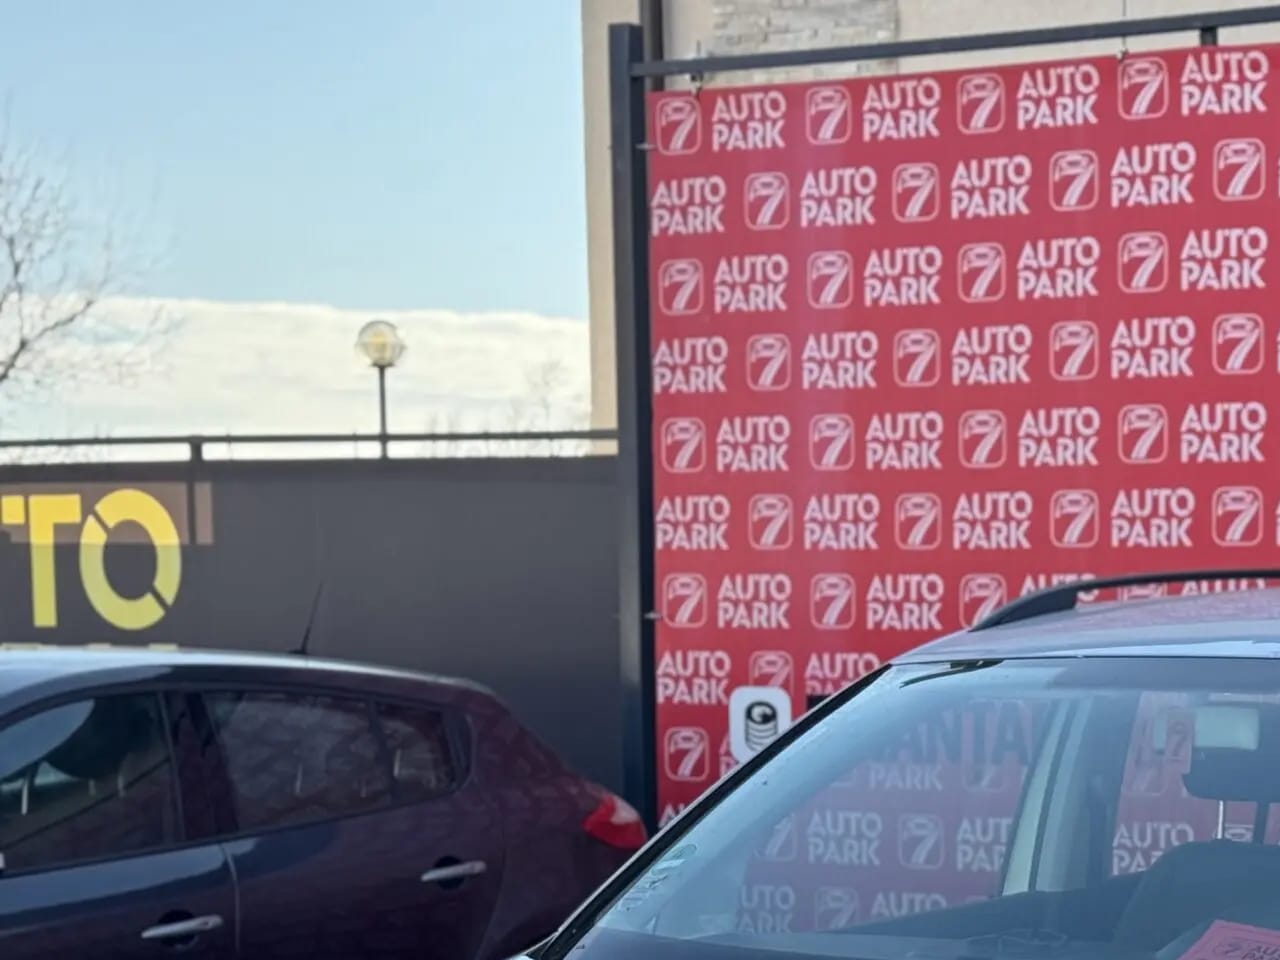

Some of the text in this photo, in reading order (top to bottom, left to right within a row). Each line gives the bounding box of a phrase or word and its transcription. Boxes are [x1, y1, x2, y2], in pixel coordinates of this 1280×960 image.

[1017, 64, 1099, 98] AUTO
[1180, 51, 1269, 86] AUTO
[711, 92, 786, 123] AUTO
[862, 78, 940, 111] AUTO
[1180, 82, 1268, 116] PARK
[862, 109, 940, 141] PARK
[1017, 95, 1098, 130] PARK
[712, 120, 786, 151] PARK
[950, 155, 1031, 189] AUTO
[1111, 142, 1195, 176] AUTO
[652, 177, 726, 207] AUTO
[800, 167, 876, 198] AUTO
[1111, 173, 1193, 207] PARK
[800, 195, 875, 227] PARK
[950, 185, 1030, 219] PARK
[652, 205, 725, 236] PARK
[1017, 236, 1099, 269] AUTO
[1180, 227, 1268, 260] AUTO
[714, 255, 788, 286] AUTO
[864, 246, 942, 278] AUTO
[1180, 257, 1266, 290] PARK
[714, 283, 787, 313] PARK
[864, 275, 941, 306] PARK
[1017, 267, 1098, 300] PARK
[802, 331, 878, 361] AUTO
[952, 324, 1032, 356] AUTO
[1111, 316, 1195, 349] AUTO
[654, 337, 728, 366] AUTO
[1111, 346, 1193, 379] PARK
[654, 364, 726, 393] PARK
[802, 359, 876, 390] PARK
[952, 353, 1031, 385] PARK
[716, 415, 790, 445] AUTO
[866, 412, 943, 442] AUTO
[1018, 407, 1100, 438] AUTO
[1180, 402, 1267, 433] AUTO
[716, 443, 788, 473] PARK
[866, 440, 942, 470] PARK
[1018, 435, 1099, 468] PARK
[1180, 431, 1265, 463] PARK
[657, 495, 730, 524] AUTO
[804, 494, 879, 522] AUTO
[953, 492, 1032, 521] AUTO
[1112, 488, 1195, 519] AUTO
[657, 522, 729, 551] PARK
[804, 520, 878, 551] PARK
[953, 520, 1031, 550] PARK
[1112, 517, 1193, 549] PARK
[1, 488, 181, 631] TO
[717, 575, 791, 602] AUTO
[866, 574, 943, 602] AUTO
[717, 600, 790, 629] PARK
[866, 600, 942, 630] PARK
[656, 651, 731, 677] AUTO
[805, 653, 877, 681] AUTO
[656, 676, 728, 704] PARK
[869, 763, 944, 792] PARK
[808, 810, 882, 837] AUTO
[957, 817, 1012, 842] AUT
[808, 836, 880, 866] PARK
